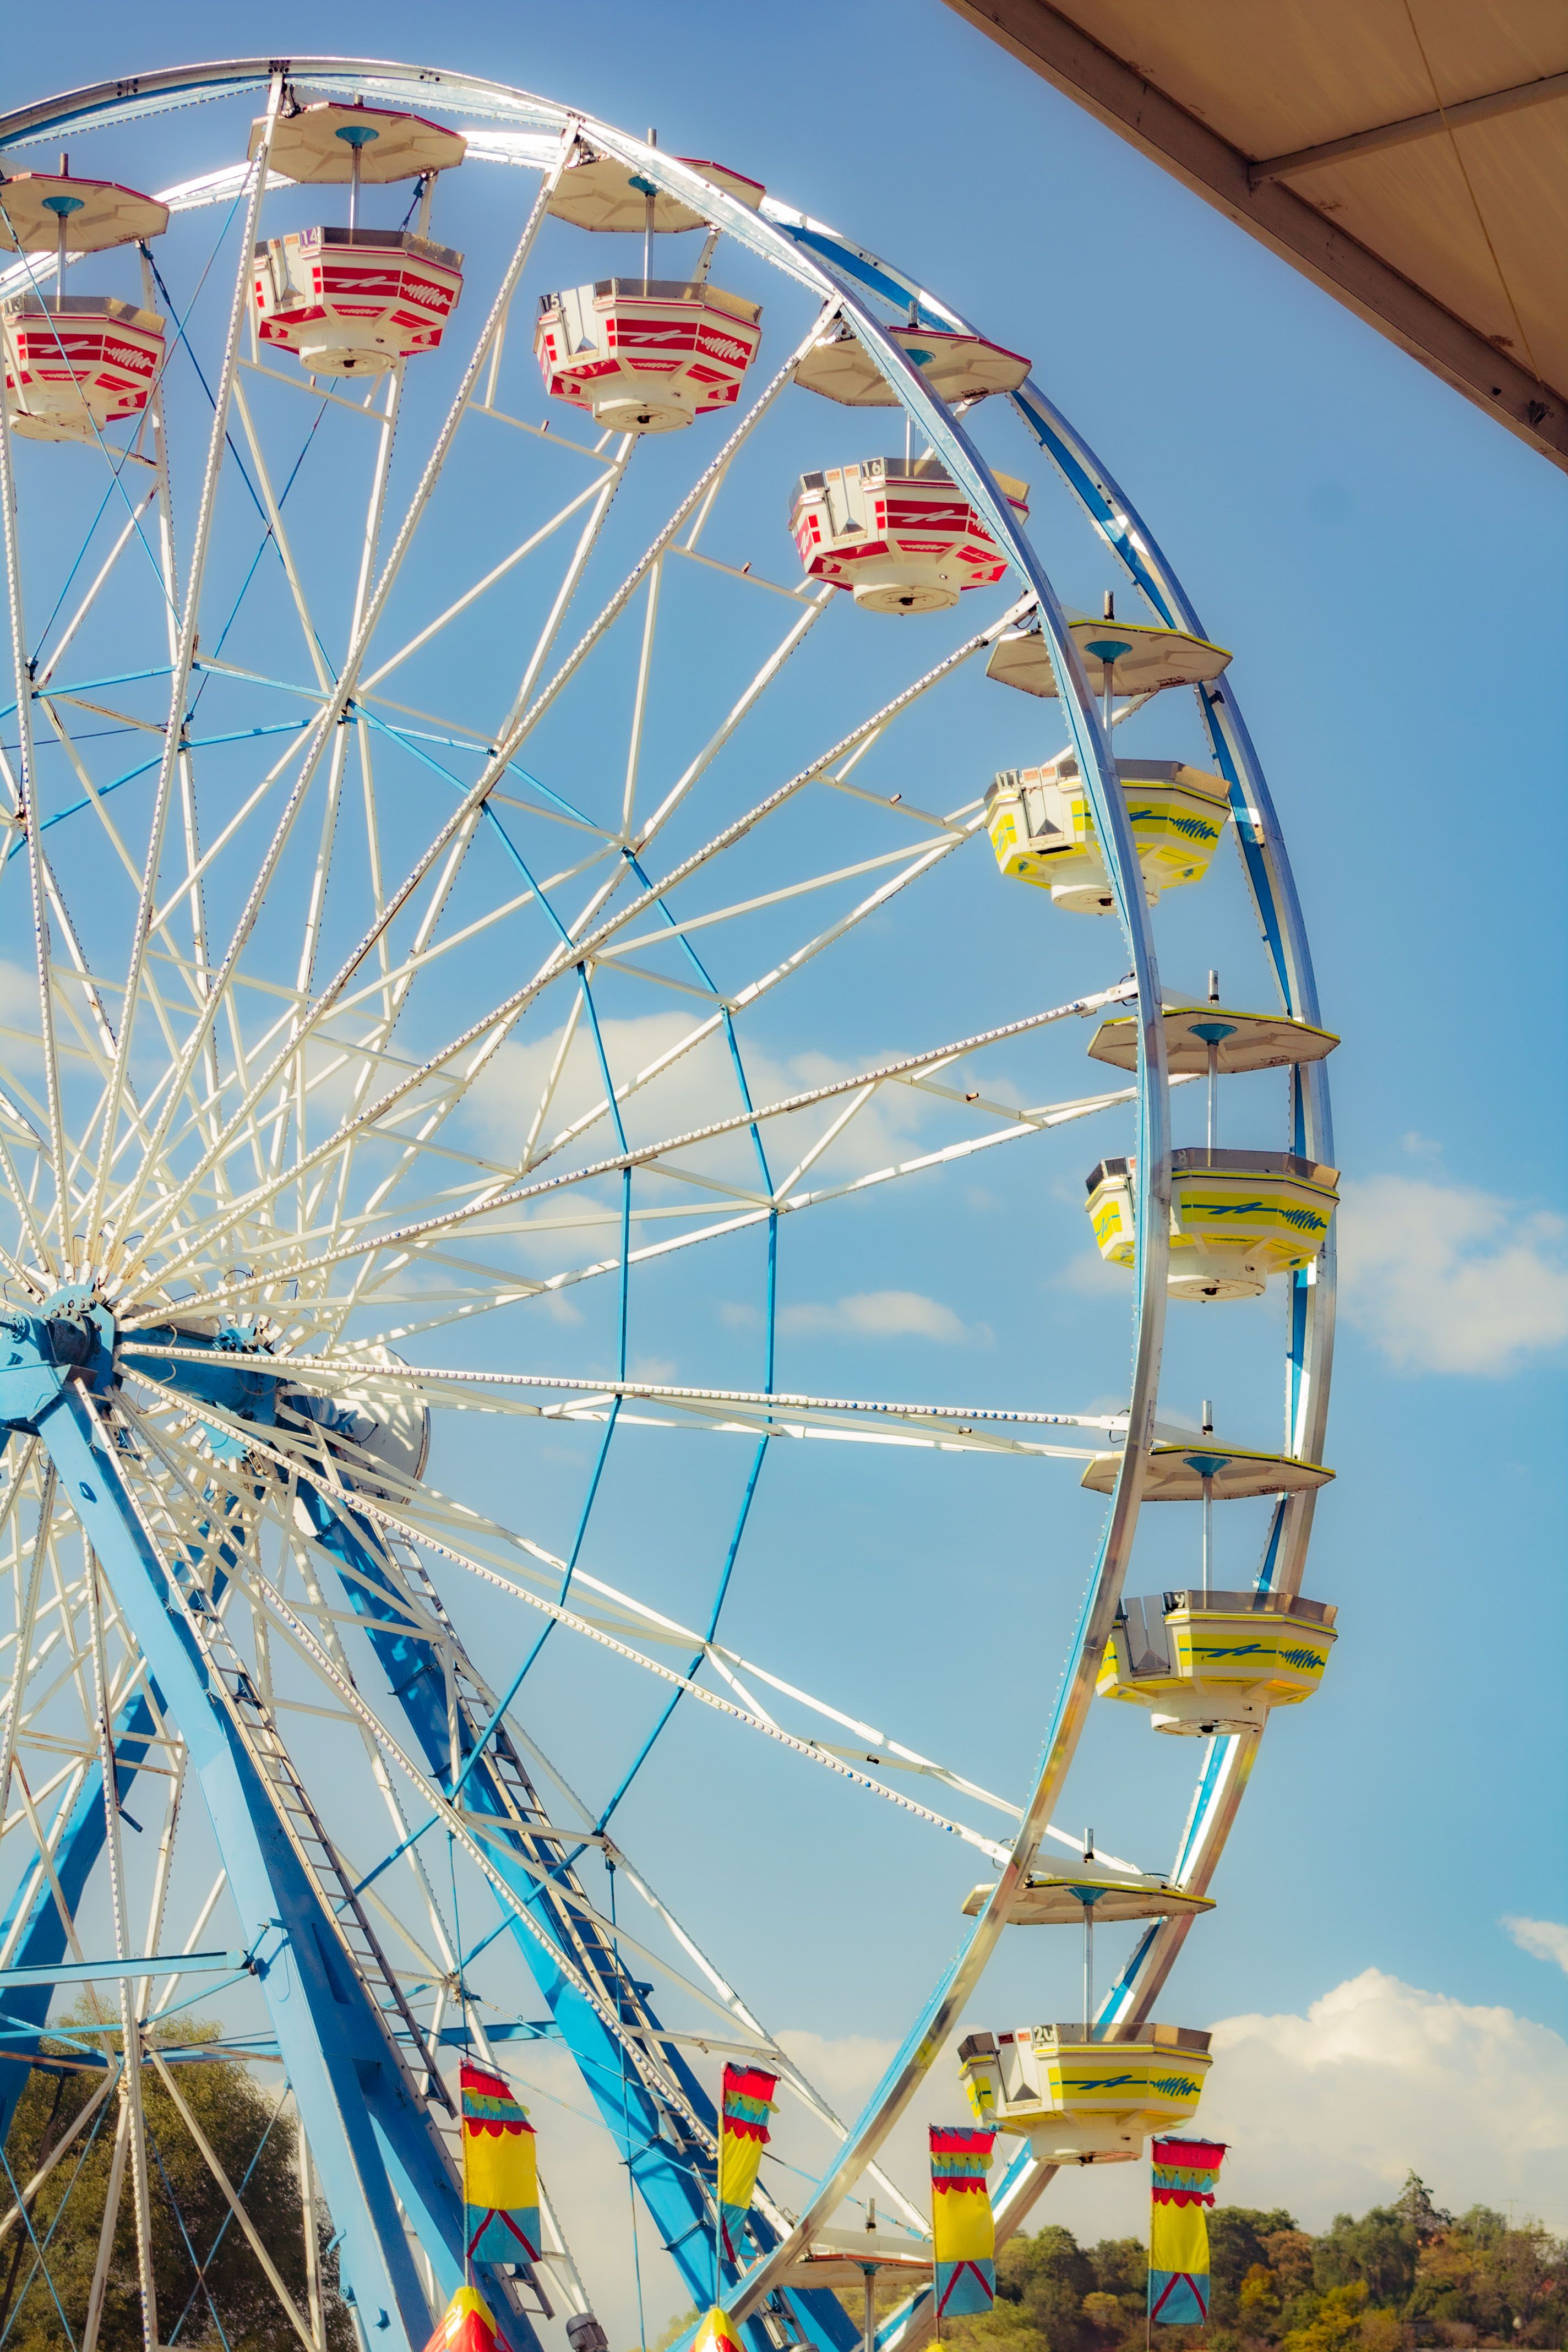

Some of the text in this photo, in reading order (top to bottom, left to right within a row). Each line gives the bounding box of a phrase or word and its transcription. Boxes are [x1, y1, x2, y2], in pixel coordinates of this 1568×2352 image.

[302, 227, 318, 246] 14
[7, 297, 22, 313] 13
[542, 292, 560, 311] 15
[862, 461, 881, 477] 16
[1164, 1593, 1185, 1608] 19
